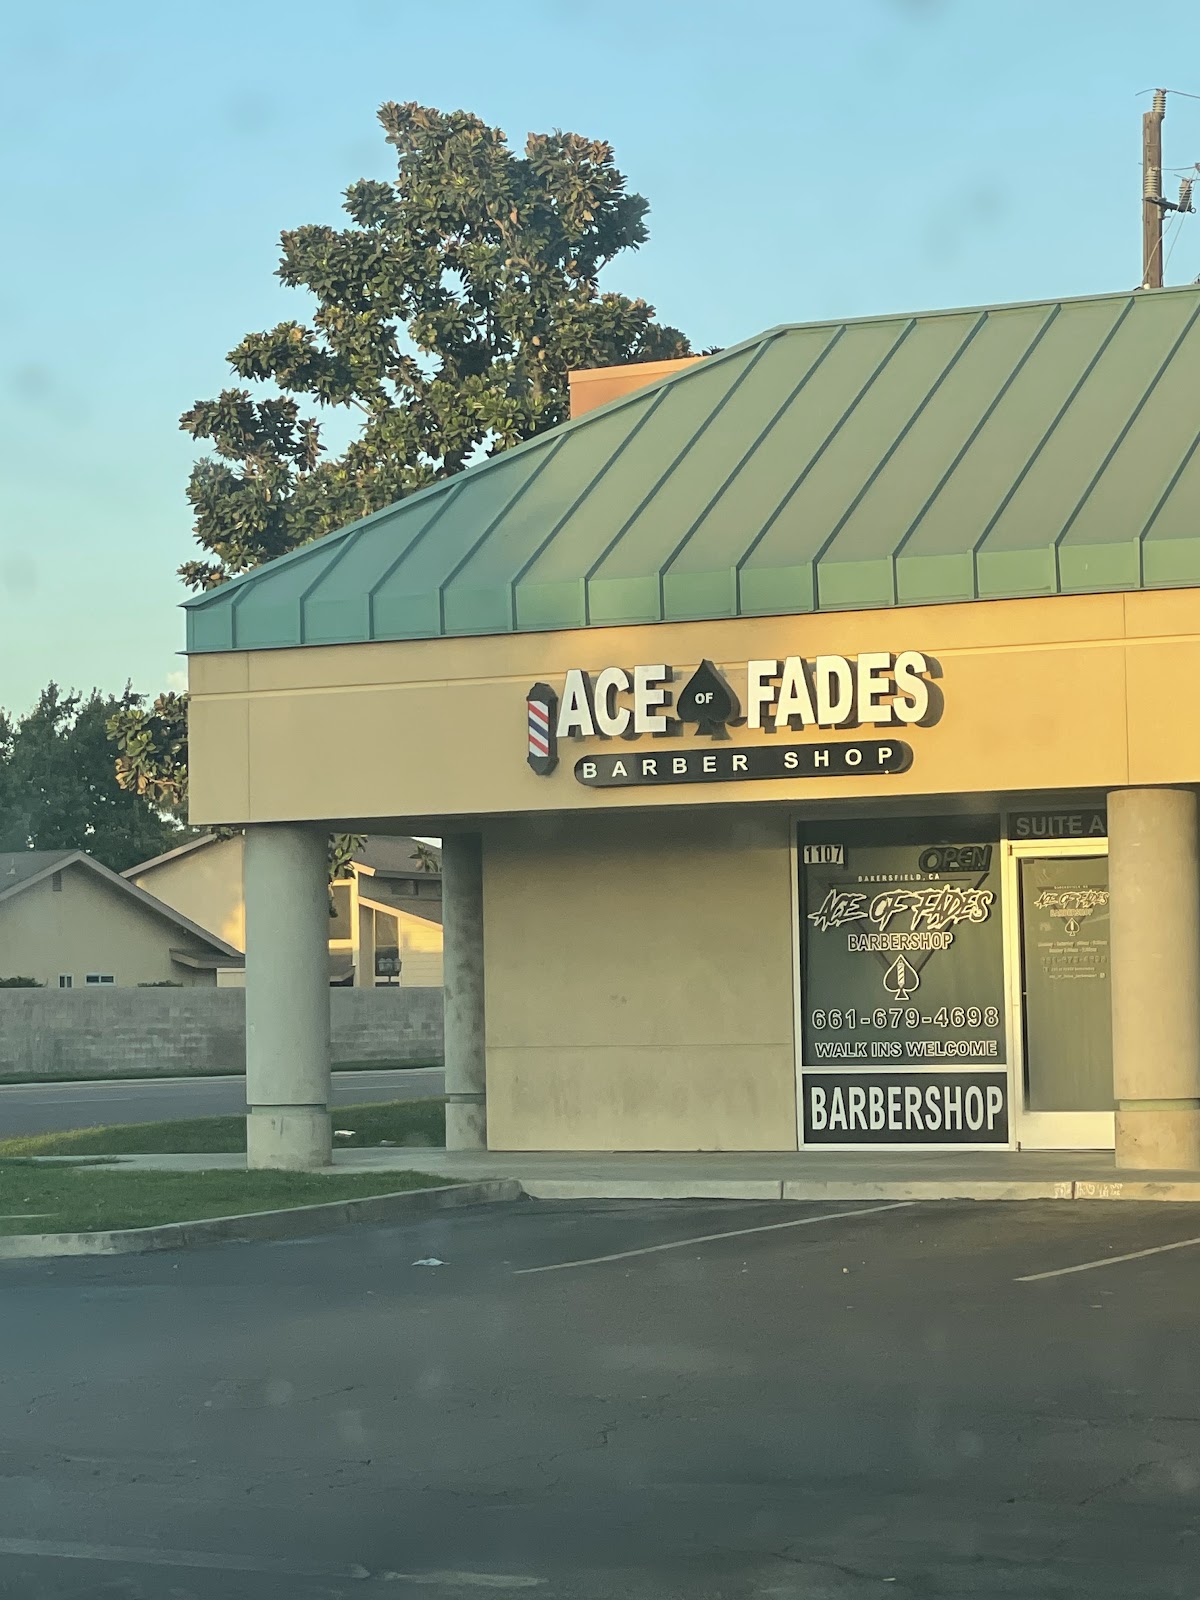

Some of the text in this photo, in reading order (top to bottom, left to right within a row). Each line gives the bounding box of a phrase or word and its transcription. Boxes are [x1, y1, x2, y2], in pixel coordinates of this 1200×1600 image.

[556, 651, 929, 737] ACE OF FADES
[582, 746, 894, 779] BARBER SHOP
[1016, 814, 1106, 836] SUITE A
[805, 845, 842, 863] 1107
[919, 845, 993, 873] OPEN
[928, 872, 940, 881] CA
[869, 890, 914, 932] OF
[911, 883, 994, 931] FADES
[848, 931, 954, 952] BARBERSHOP
[811, 1006, 1000, 1030] 661-679-4698
[815, 1040, 998, 1058] WALK INS WELCOME
[811, 1085, 1003, 1131] BARBERSHOP
